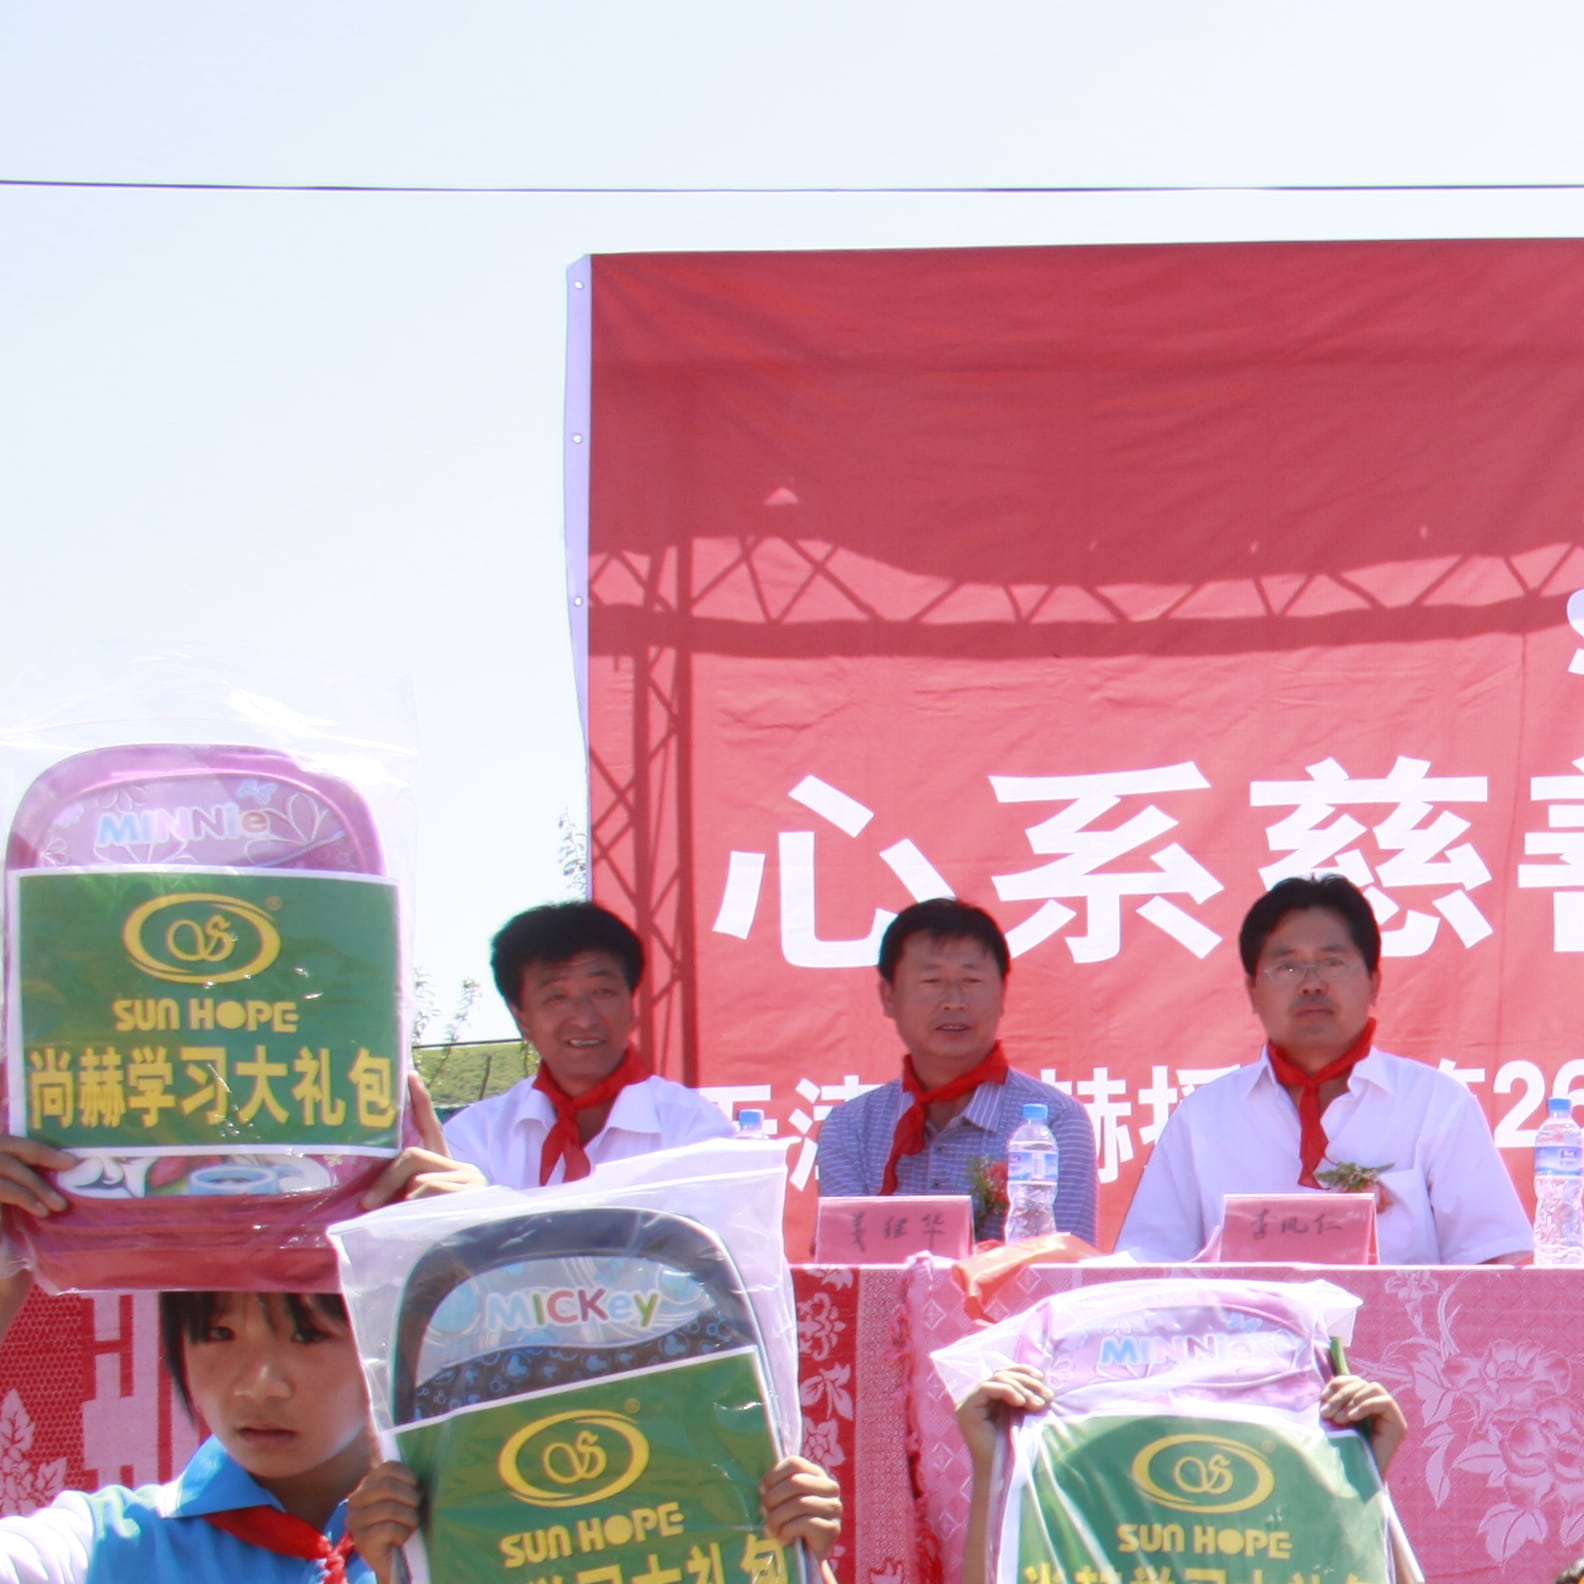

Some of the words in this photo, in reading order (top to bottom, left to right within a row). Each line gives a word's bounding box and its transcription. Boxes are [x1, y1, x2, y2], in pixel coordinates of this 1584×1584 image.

[112, 999, 178, 1032] SUN
[191, 1000, 297, 1031] HOPE
[27, 1045, 397, 1130] 尚赫学习大礼包
[500, 1527, 571, 1568] SUN
[574, 1498, 683, 1552] HOPE
[1118, 1526, 1183, 1551] SUN
[1196, 1529, 1286, 1557] HOPE
